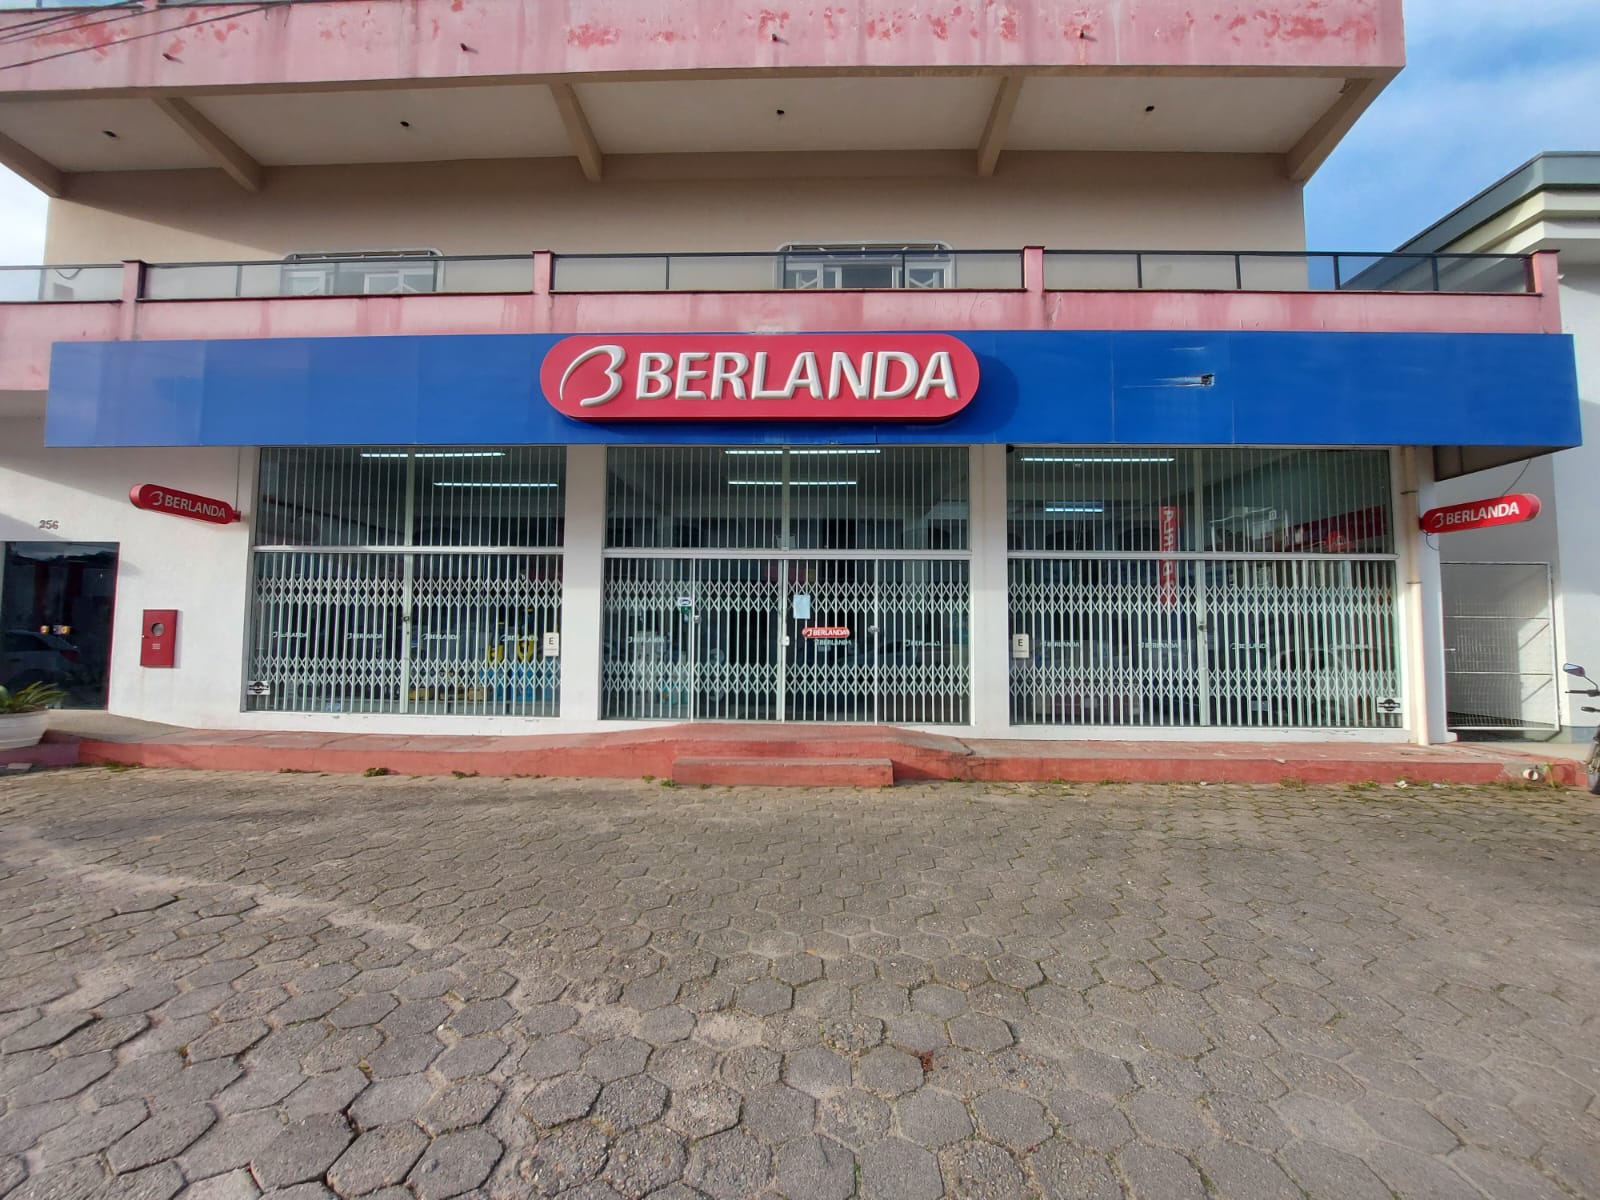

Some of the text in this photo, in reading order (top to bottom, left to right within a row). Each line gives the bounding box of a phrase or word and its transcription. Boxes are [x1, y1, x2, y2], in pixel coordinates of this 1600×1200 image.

[636, 351, 959, 400] BERLANDA
[164, 495, 226, 518] BERLANDA
[1446, 502, 1519, 525] BERLANDA
[39, 520, 59, 530] 256
[1018, 639, 1023, 647] E
